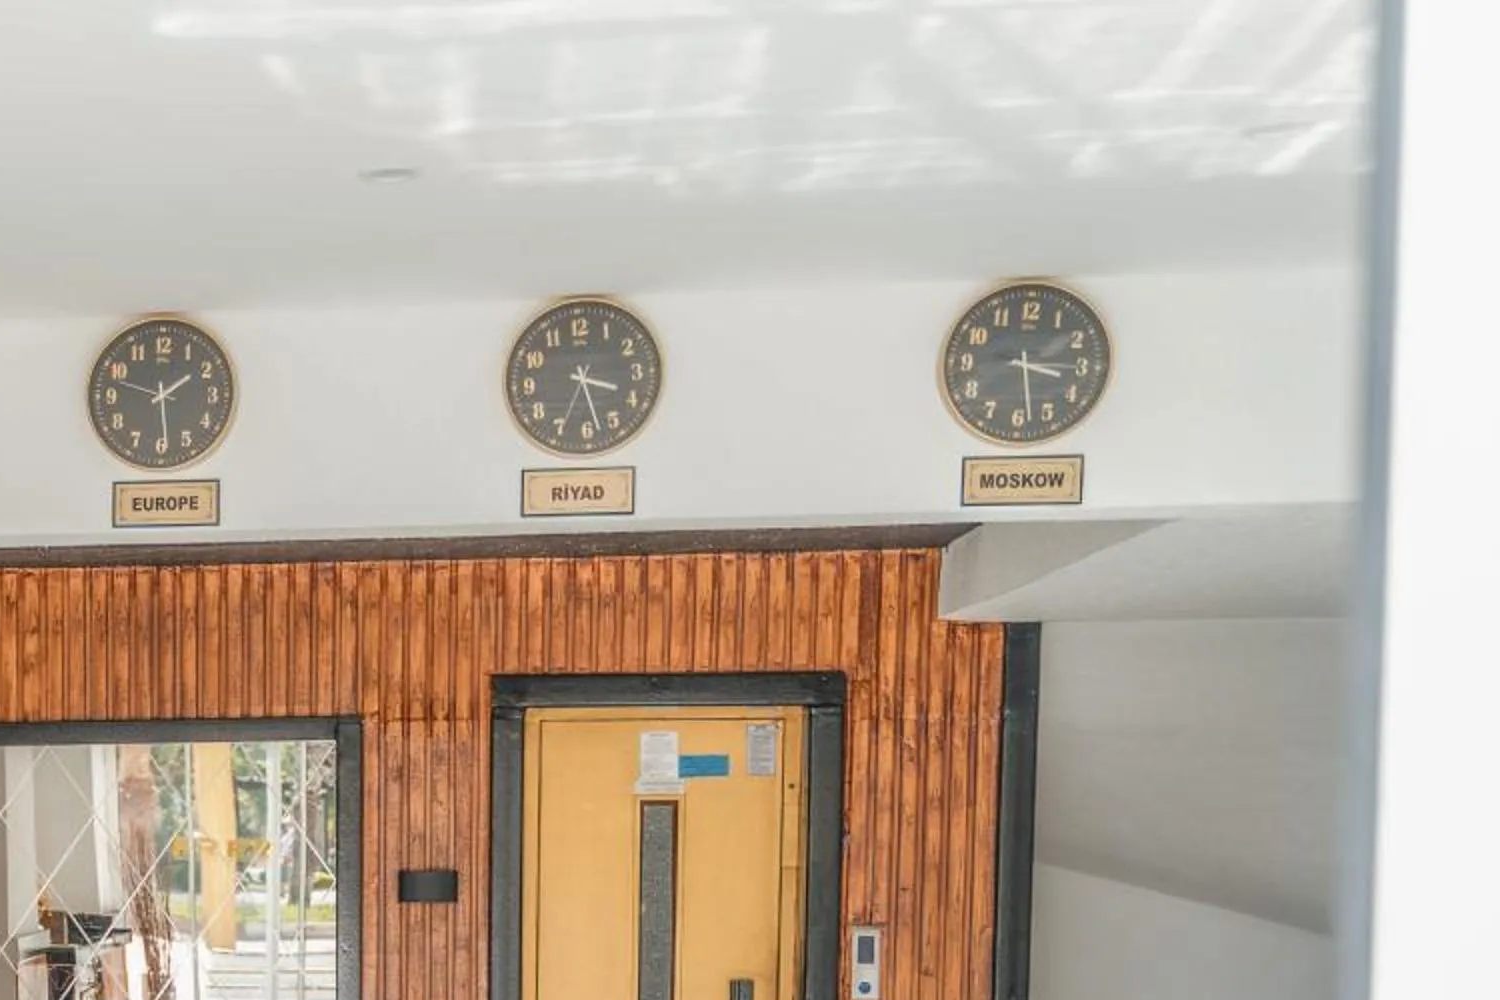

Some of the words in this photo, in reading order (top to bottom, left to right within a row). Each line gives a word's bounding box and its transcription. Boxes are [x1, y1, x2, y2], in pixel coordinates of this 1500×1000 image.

[994, 307, 1009, 326] 11
[1021, 302, 1041, 320] 12
[1054, 310, 1062, 328] 1
[572, 318, 589, 337] 12
[603, 322, 610, 339] 1
[969, 327, 987, 345] 10
[156, 336, 172, 353] 12
[545, 328, 560, 346] 11
[1070, 331, 1084, 348] 2
[131, 344, 145, 360] 11
[185, 343, 192, 360] 1
[621, 338, 634, 356] 2
[526, 351, 544, 368] 10
[960, 354, 973, 371] 9
[1075, 358, 1088, 376] 3
[110, 362, 127, 380] 10
[201, 362, 212, 378] 2
[631, 363, 643, 380] 3
[207, 387, 218, 403] 3
[523, 378, 535, 395] 9
[964, 381, 978, 398] 8
[1065, 385, 1077, 402] 4
[106, 388, 117, 404] 9
[627, 391, 637, 408] 4
[532, 402, 544, 419] 8
[985, 401, 996, 419] 7
[1012, 409, 1024, 426] 6
[1041, 404, 1053, 421] 5
[112, 413, 124, 429] 8
[200, 413, 210, 428] 4
[554, 418, 565, 435] 7
[607, 411, 620, 428] 5
[581, 421, 593, 439] 6
[131, 431, 141, 448] 7
[156, 438, 168, 454] 6
[181, 431, 192, 447] 5
[979, 471, 1065, 489] MOSKOW
[132, 495, 199, 512] EUROPE
